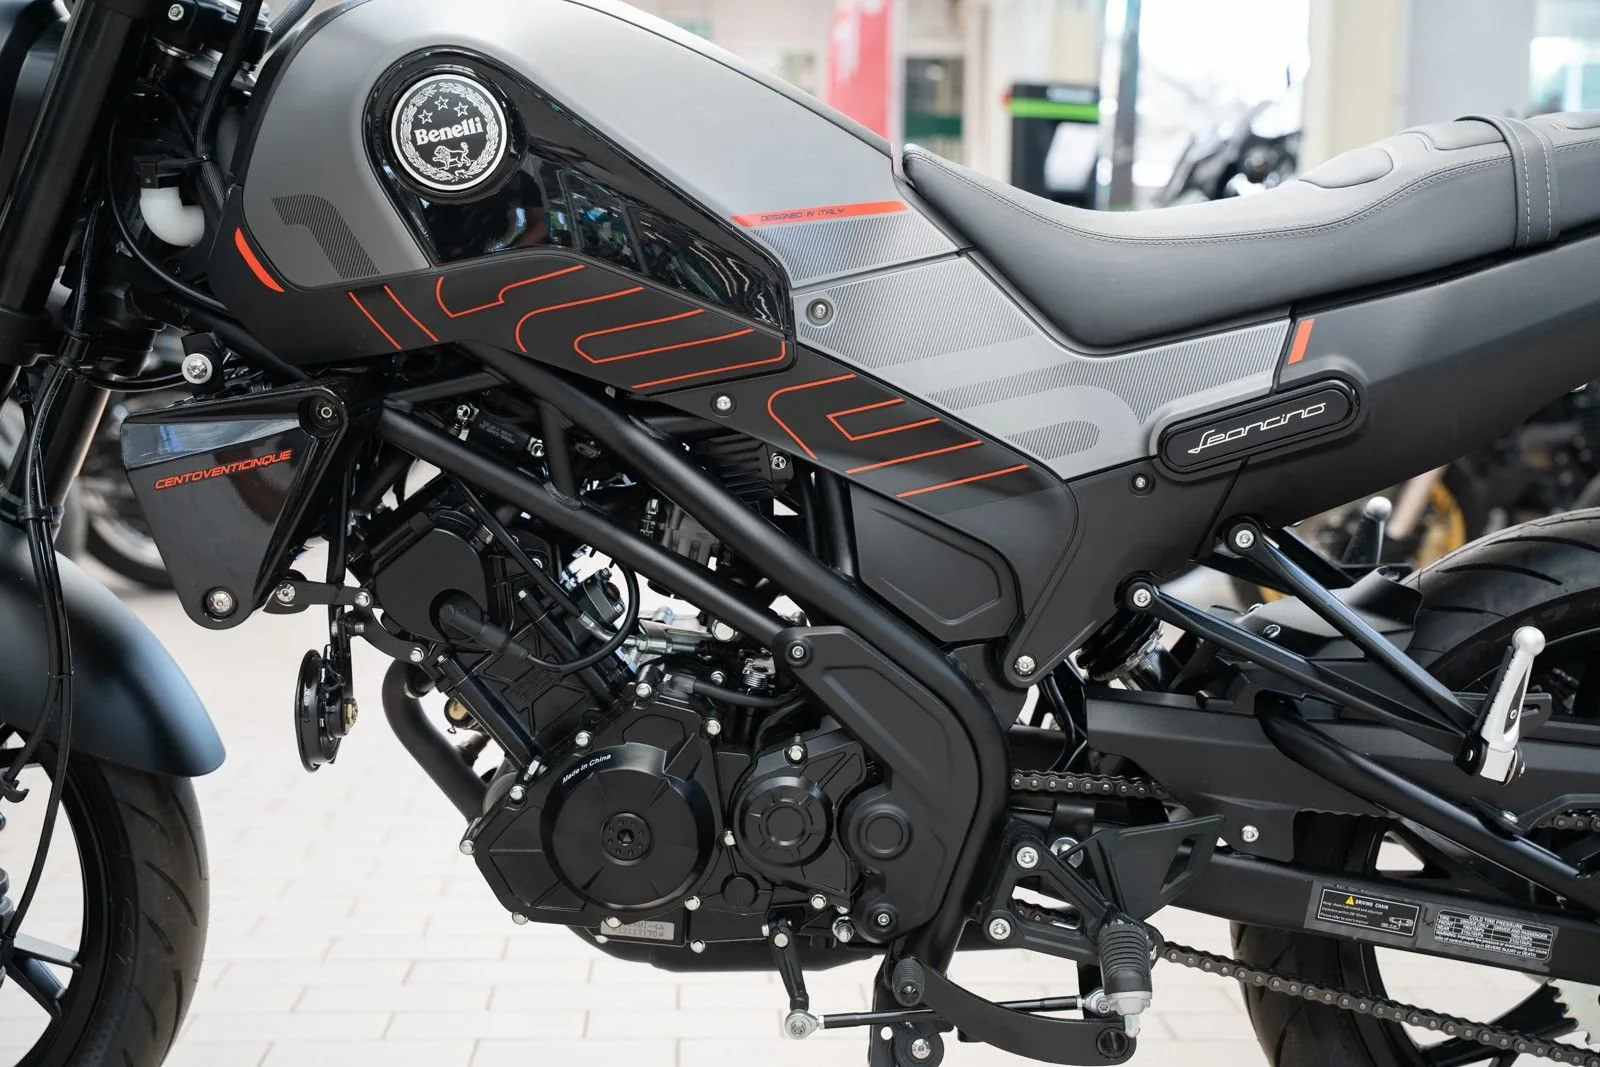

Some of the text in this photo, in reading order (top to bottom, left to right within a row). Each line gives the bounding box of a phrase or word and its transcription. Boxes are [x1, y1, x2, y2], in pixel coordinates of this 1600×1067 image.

[414, 116, 483, 145] Benelli
[761, 212, 802, 221] DESIGNED
[817, 207, 845, 216] ITALY
[155, 450, 292, 489] CENTOVENTICINQUE
[562, 754, 611, 784] Made in China
[1354, 899, 1389, 910] DRIVING CHAIN
[1468, 914, 1484, 922] COLD
[1495, 920, 1522, 929] PRESSURE
